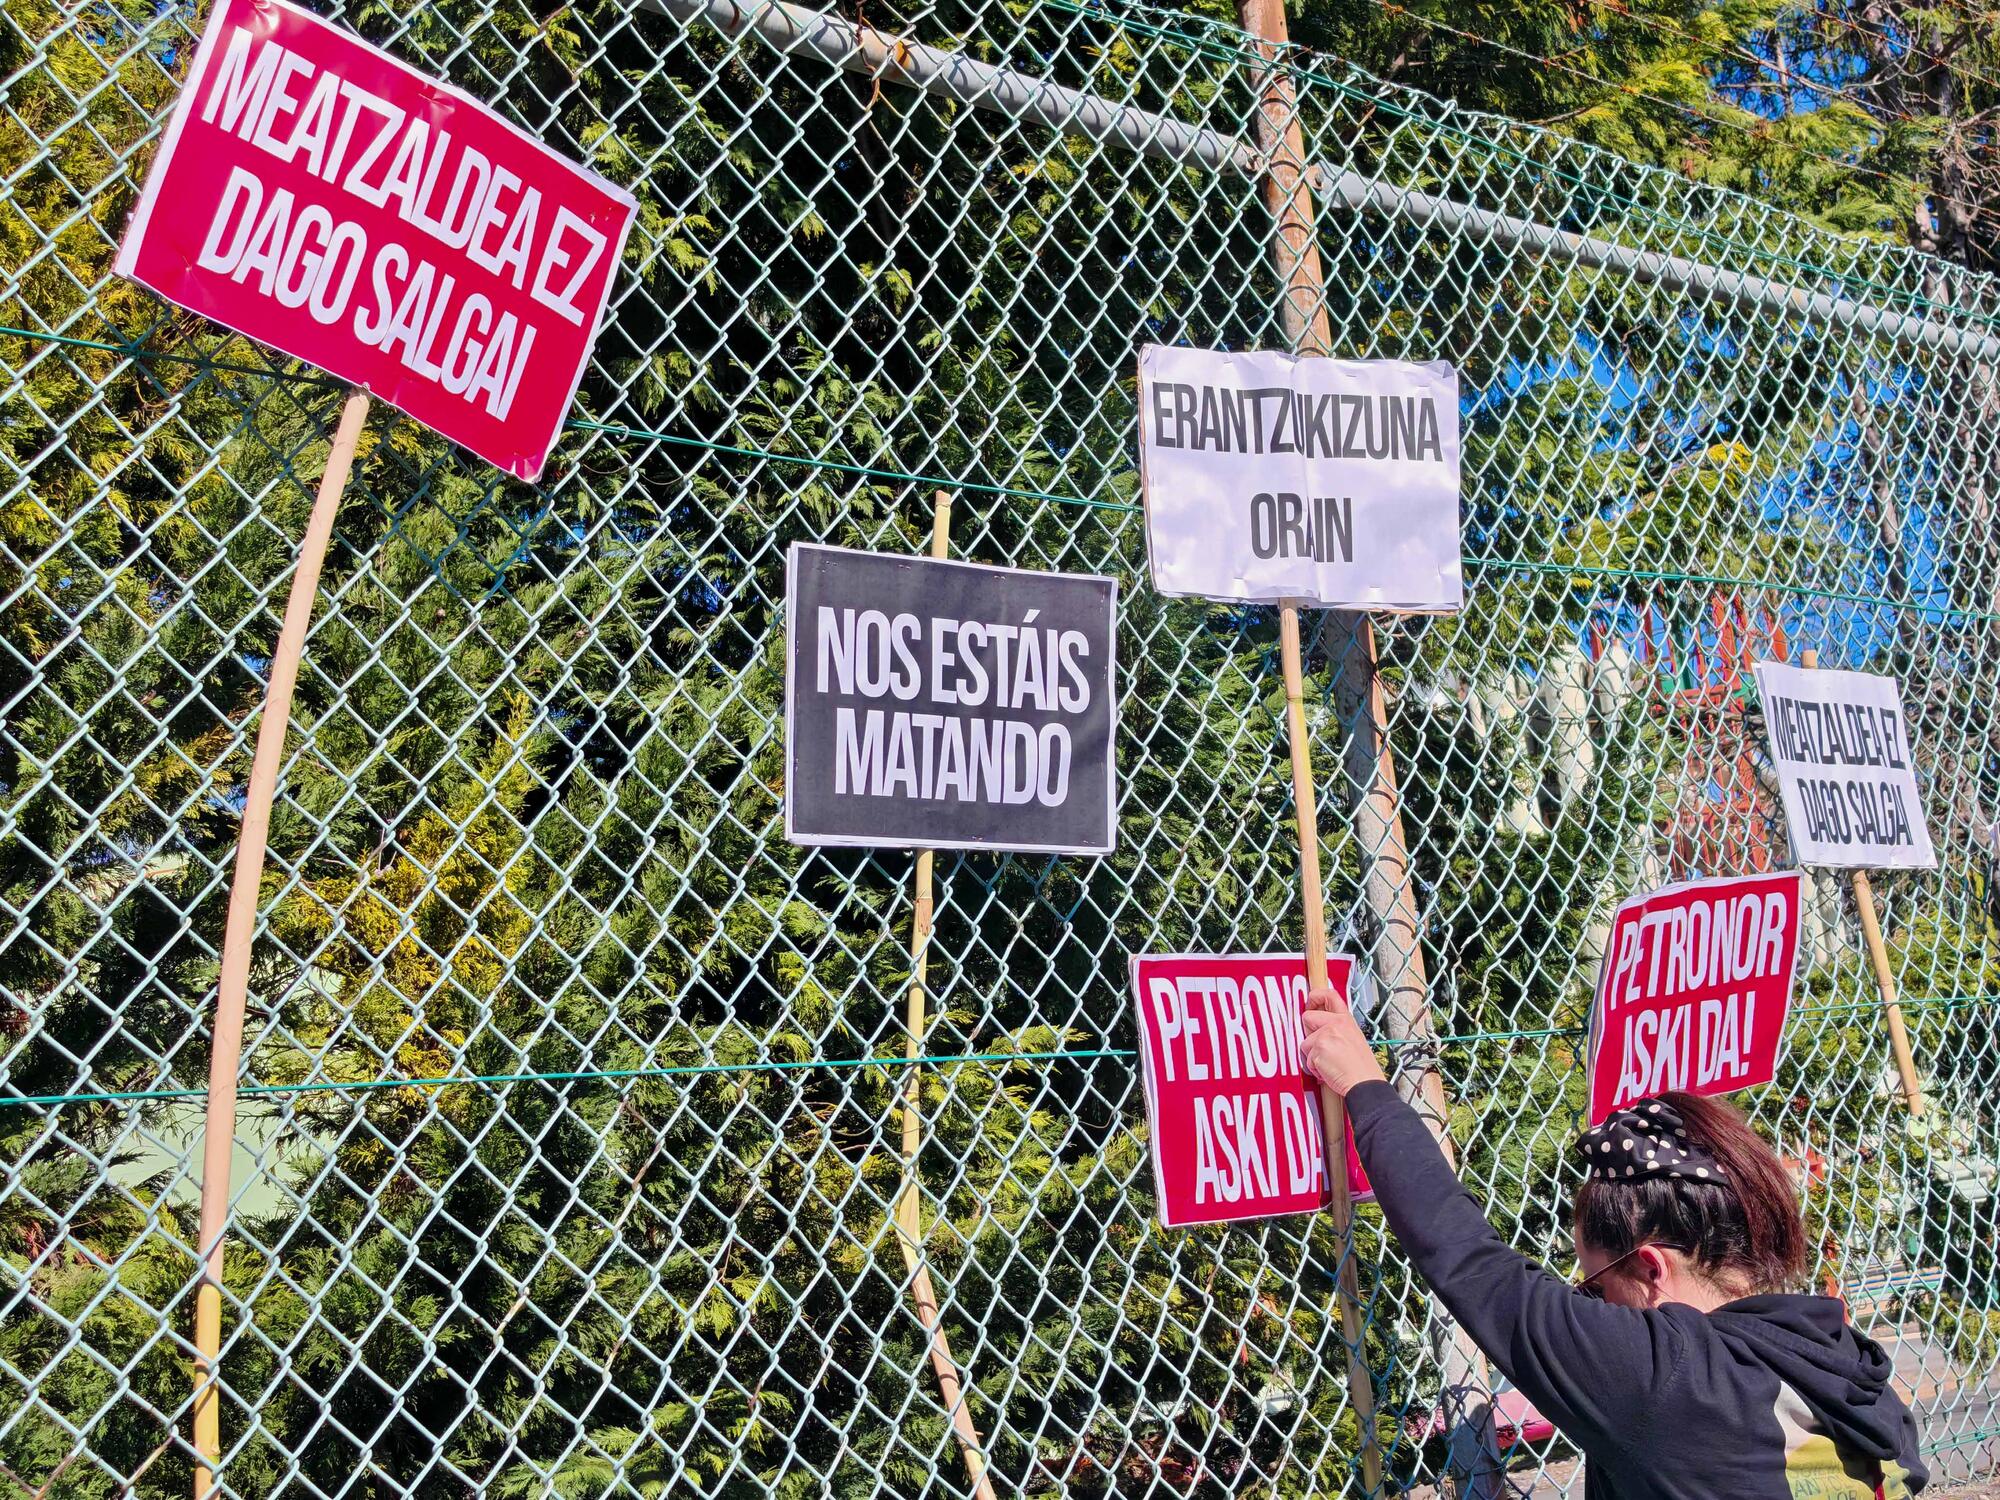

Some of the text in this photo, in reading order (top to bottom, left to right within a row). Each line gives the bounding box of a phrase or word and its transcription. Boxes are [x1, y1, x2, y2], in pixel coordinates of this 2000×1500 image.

[203, 26, 608, 327] MEATZALDEA EZ
[197, 165, 537, 423] DAGO SALGAI
[1152, 381, 1443, 462] ERANTZUKIZUNA
[1250, 492, 1353, 563] ORAIN
[816, 605, 1091, 714] NOS ESTÁIS
[835, 707, 1072, 807] MATANDO
[1771, 696, 1907, 770] MEATZALDEA EZ
[1796, 778, 1914, 846] DAGO SALGAI
[1610, 892, 1788, 1011] PETRONOR
[1612, 990, 1757, 1106] ASKI DA!
[1193, 1092, 1280, 1205] ASKI
